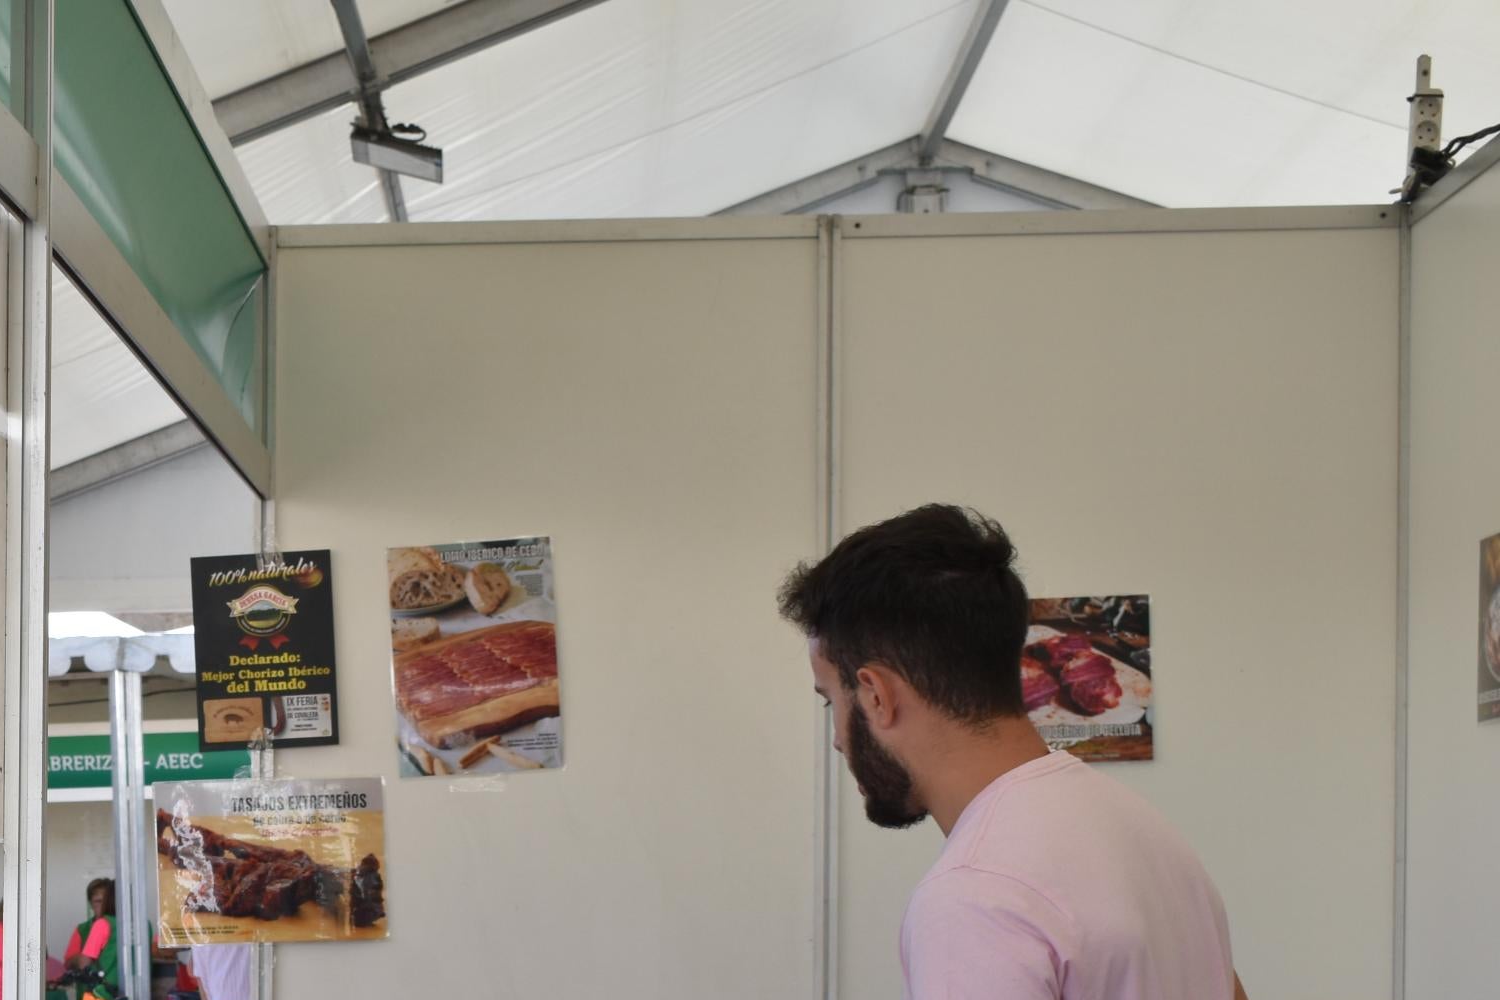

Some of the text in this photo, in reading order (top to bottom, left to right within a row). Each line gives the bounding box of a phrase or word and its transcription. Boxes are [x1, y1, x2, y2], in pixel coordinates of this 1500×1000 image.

[229, 653, 301, 666] Declarado:
[202, 666, 330, 683] Mejor Chorizo Ibérico
[227, 678, 306, 693] del Mundo
[156, 753, 204, 769] AEEC
[232, 791, 367, 812] TASAJOS EXTREMEÑOS
